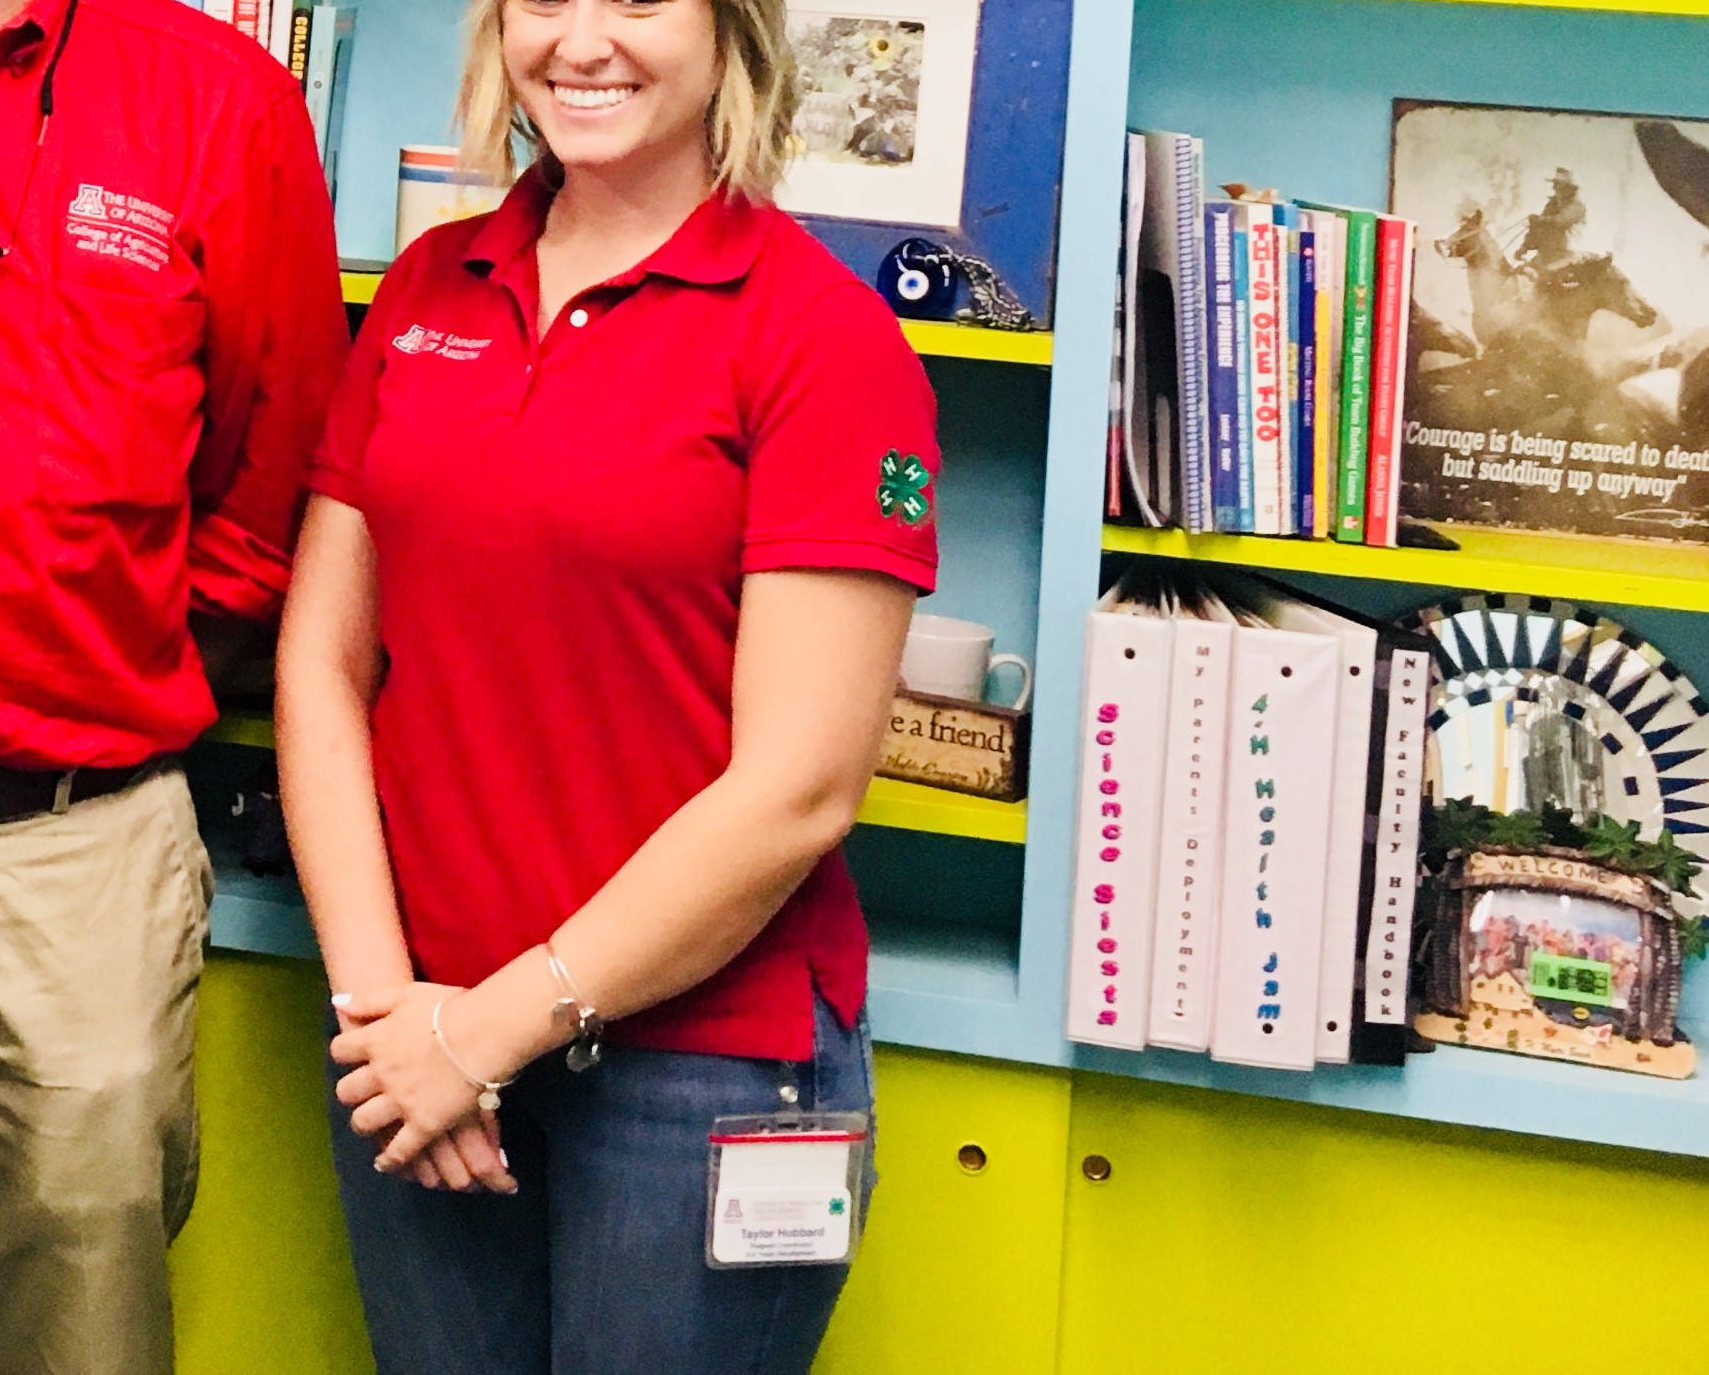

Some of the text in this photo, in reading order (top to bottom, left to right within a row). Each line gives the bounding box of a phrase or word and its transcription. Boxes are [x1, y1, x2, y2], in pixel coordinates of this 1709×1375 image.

[103, 190, 126, 206] THE
[109, 207, 126, 220] OF
[66, 222, 123, 243] College of
[76, 240, 99, 252] and
[99, 242, 121, 257] Life
[1252, 222, 1273, 302] THIS
[1213, 211, 1234, 368] PROCESSING THE EXPERIENCE
[1255, 312, 1276, 375] ONE
[1256, 385, 1281, 442] TOO
[1346, 314, 1367, 506] The Big Book of Team Building Games
[883, 456, 897, 476] H
[1490, 428, 1508, 454] is
[1511, 430, 1567, 464] being
[1570, 440, 1638, 466] scared
[1641, 443, 1661, 468] to
[1665, 445, 1709, 472] deat
[904, 464, 922, 482] H
[1373, 454, 1389, 518] ALANNA JONES
[1442, 453, 1475, 478] but
[1478, 457, 1564, 494] saddling
[1567, 469, 1593, 496] up
[903, 496, 922, 516] H
[891, 710, 1006, 754] e a friend
[1096, 702, 1122, 863] Science
[1176, 645, 1210, 1008] My Deployment
[1380, 657, 1417, 1016] New Faculty Handbook
[1249, 692, 1281, 1020] 4-H Health Jam
[1497, 859, 1610, 884] WELCOME
[741, 1226, 825, 1241] Taylor Hubbard
